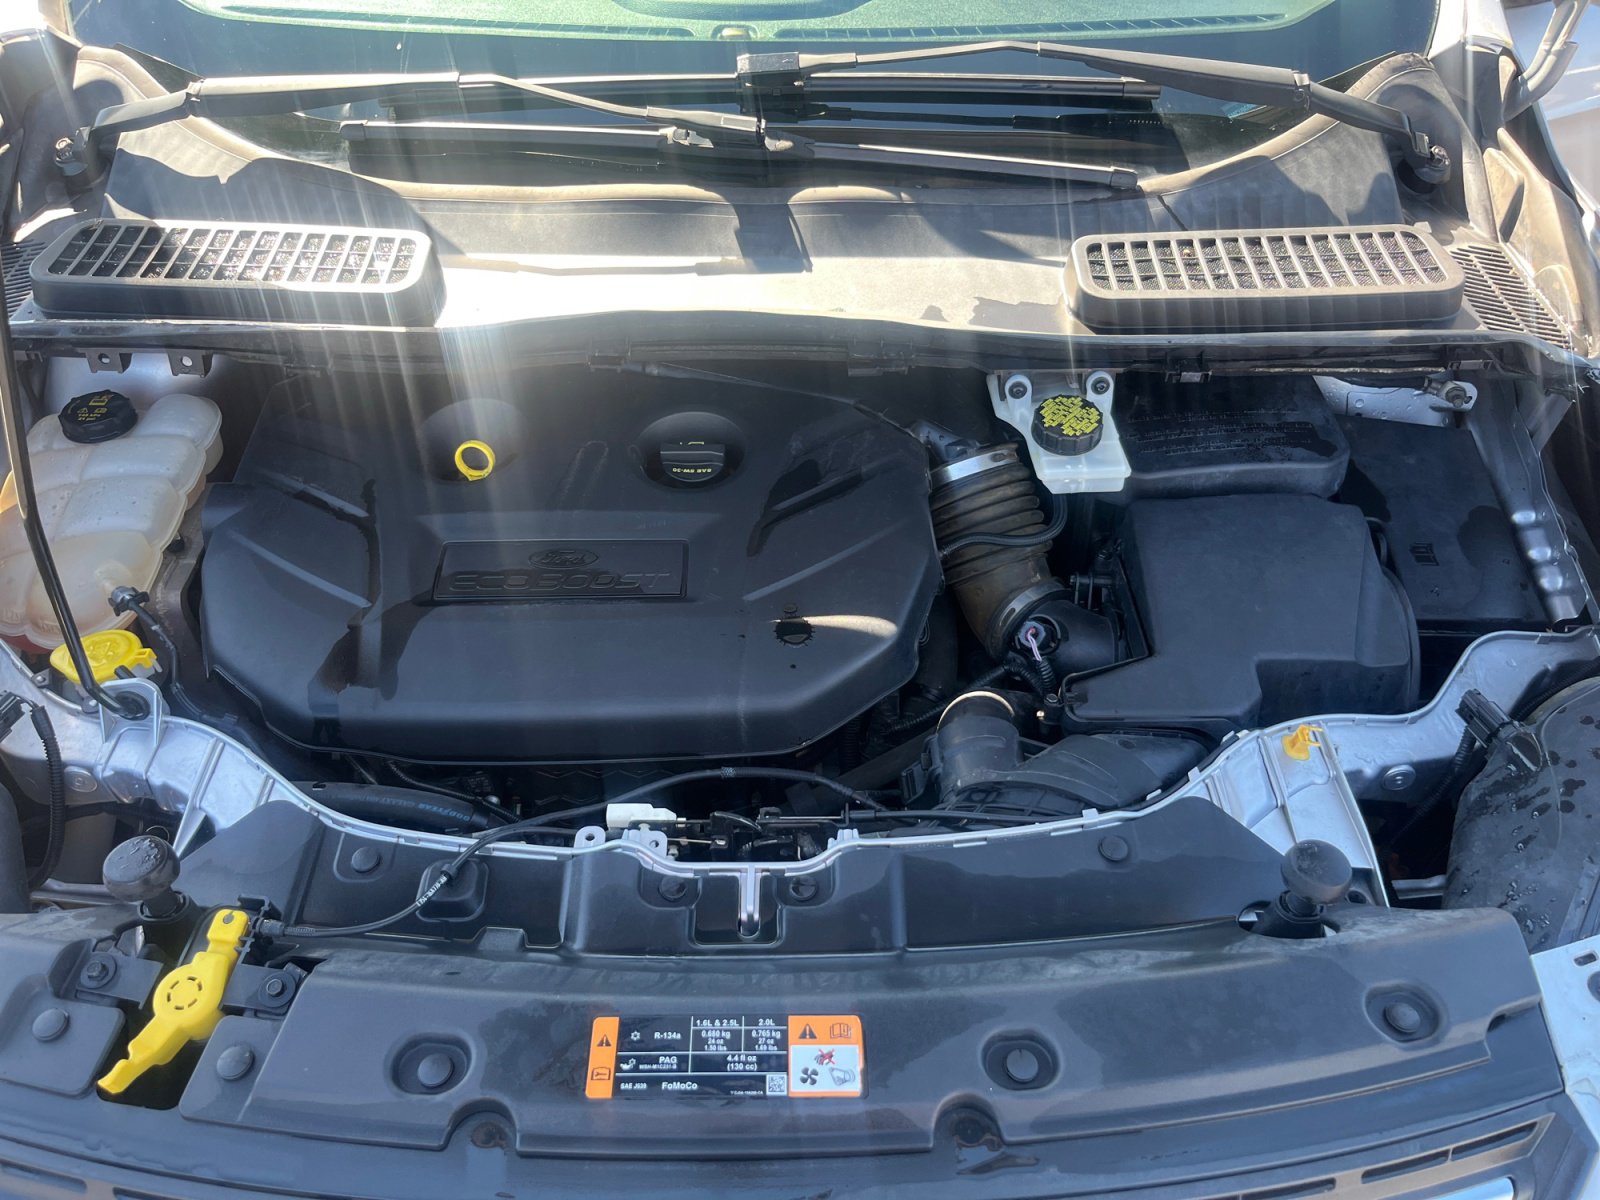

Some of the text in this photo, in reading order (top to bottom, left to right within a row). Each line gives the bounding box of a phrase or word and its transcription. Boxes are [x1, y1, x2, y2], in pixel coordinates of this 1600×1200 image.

[540, 549, 586, 566] Ford
[449, 573, 671, 592] ECOBOOST
[696, 1019, 739, 1027] 1.6L & 2.5L
[758, 1018, 775, 1026] 2.0L
[654, 1031, 681, 1039] R-134a
[721, 1030, 731, 1039] kg
[772, 1030, 781, 1039] kg
[726, 1054, 738, 1062] 4.4
[740, 1054, 745, 1062] fl
[727, 1063, 757, 1071] (130 cc)
[661, 1081, 698, 1090] FoMoCo
